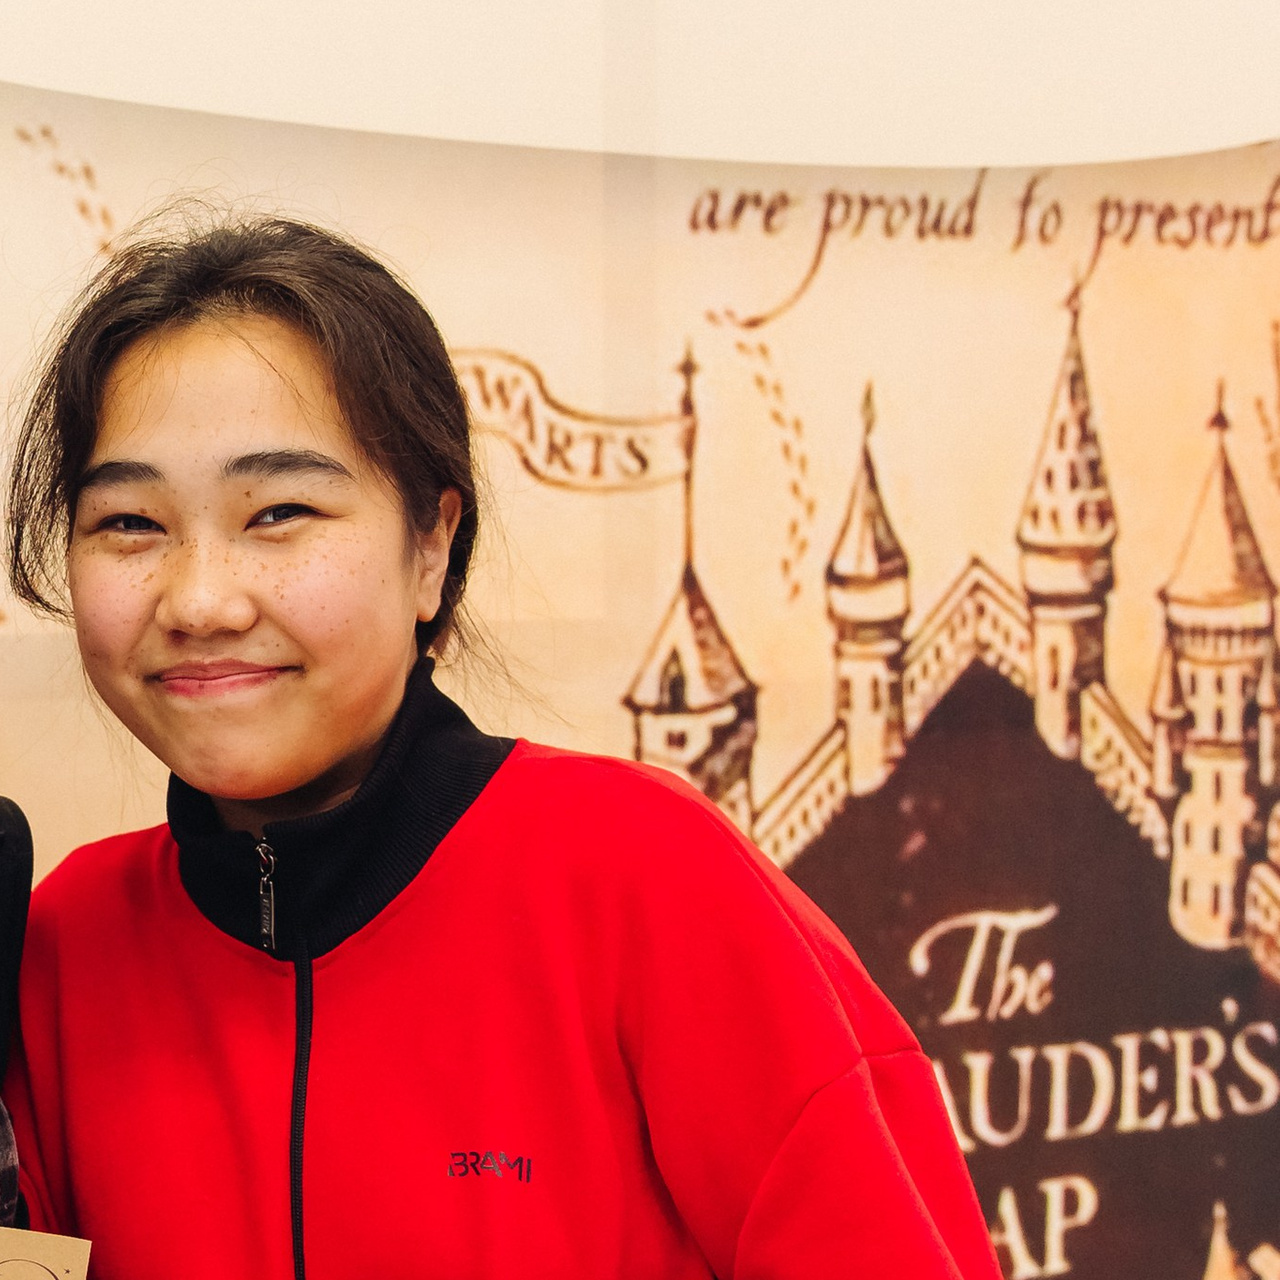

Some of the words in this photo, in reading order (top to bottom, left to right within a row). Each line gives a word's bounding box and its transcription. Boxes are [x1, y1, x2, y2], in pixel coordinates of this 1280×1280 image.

[689, 188, 792, 238] are
[471, 366, 649, 477] WARTS
[909, 904, 1059, 1024] The
